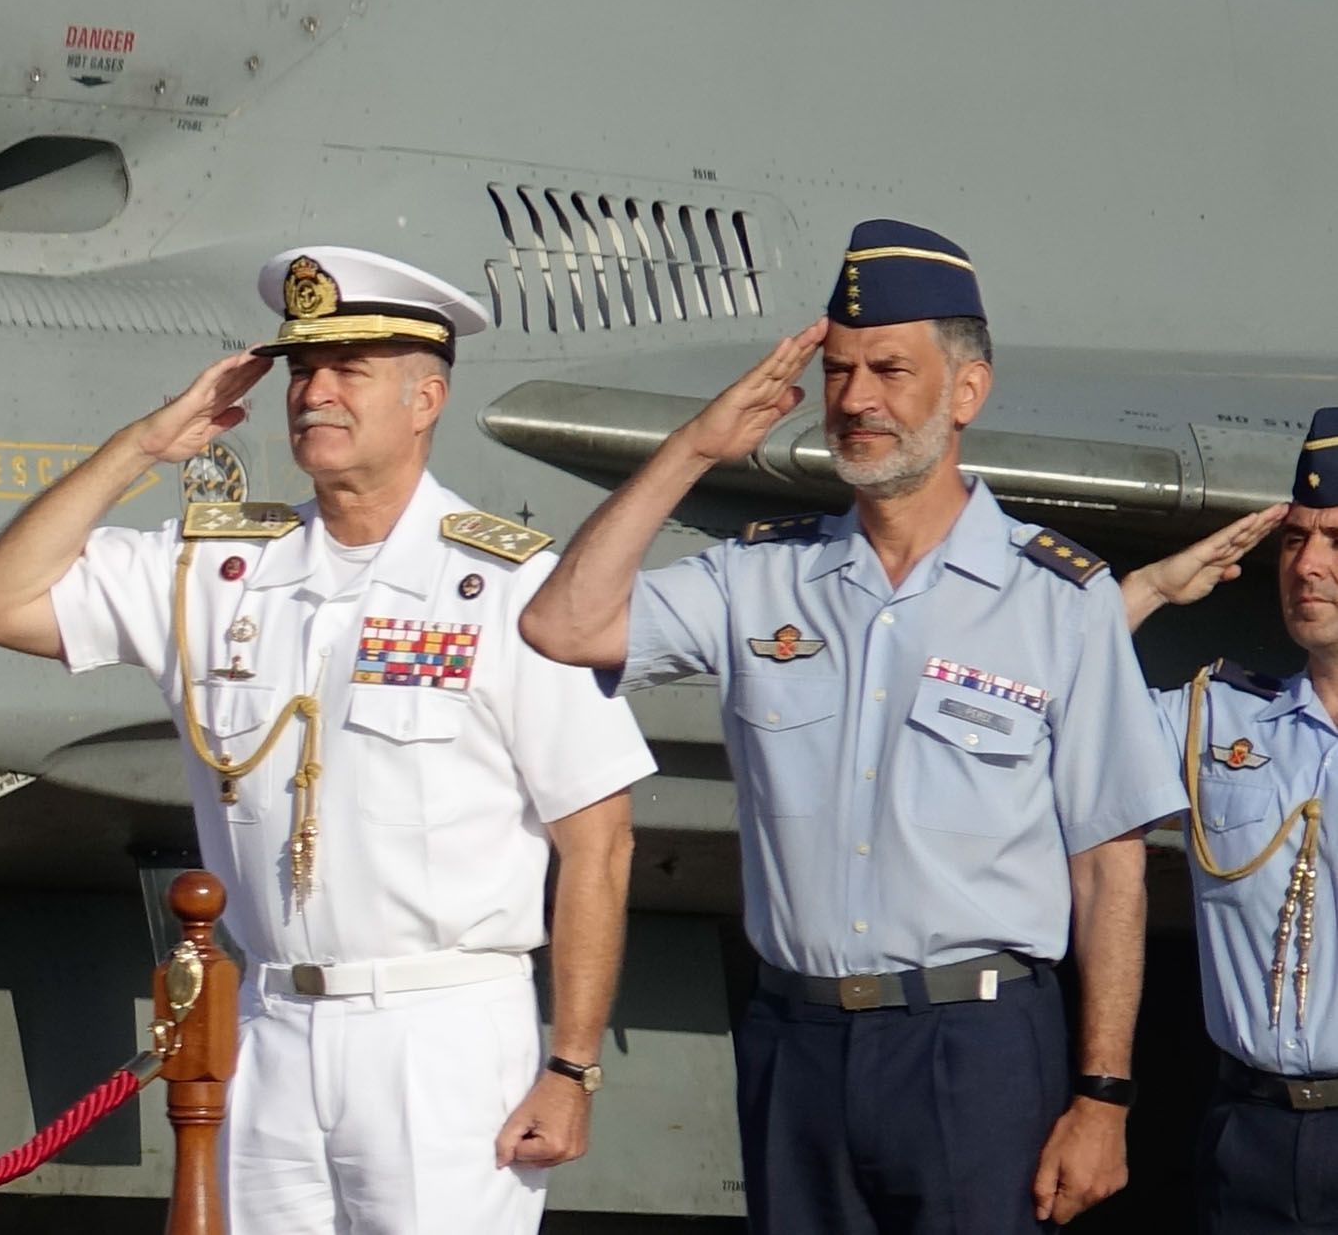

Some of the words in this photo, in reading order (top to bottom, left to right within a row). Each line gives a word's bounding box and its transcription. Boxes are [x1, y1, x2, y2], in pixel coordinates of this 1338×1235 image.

[66, 26, 135, 53] DANGER
[67, 54, 87, 69] HOT
[90, 55, 124, 72] GASES
